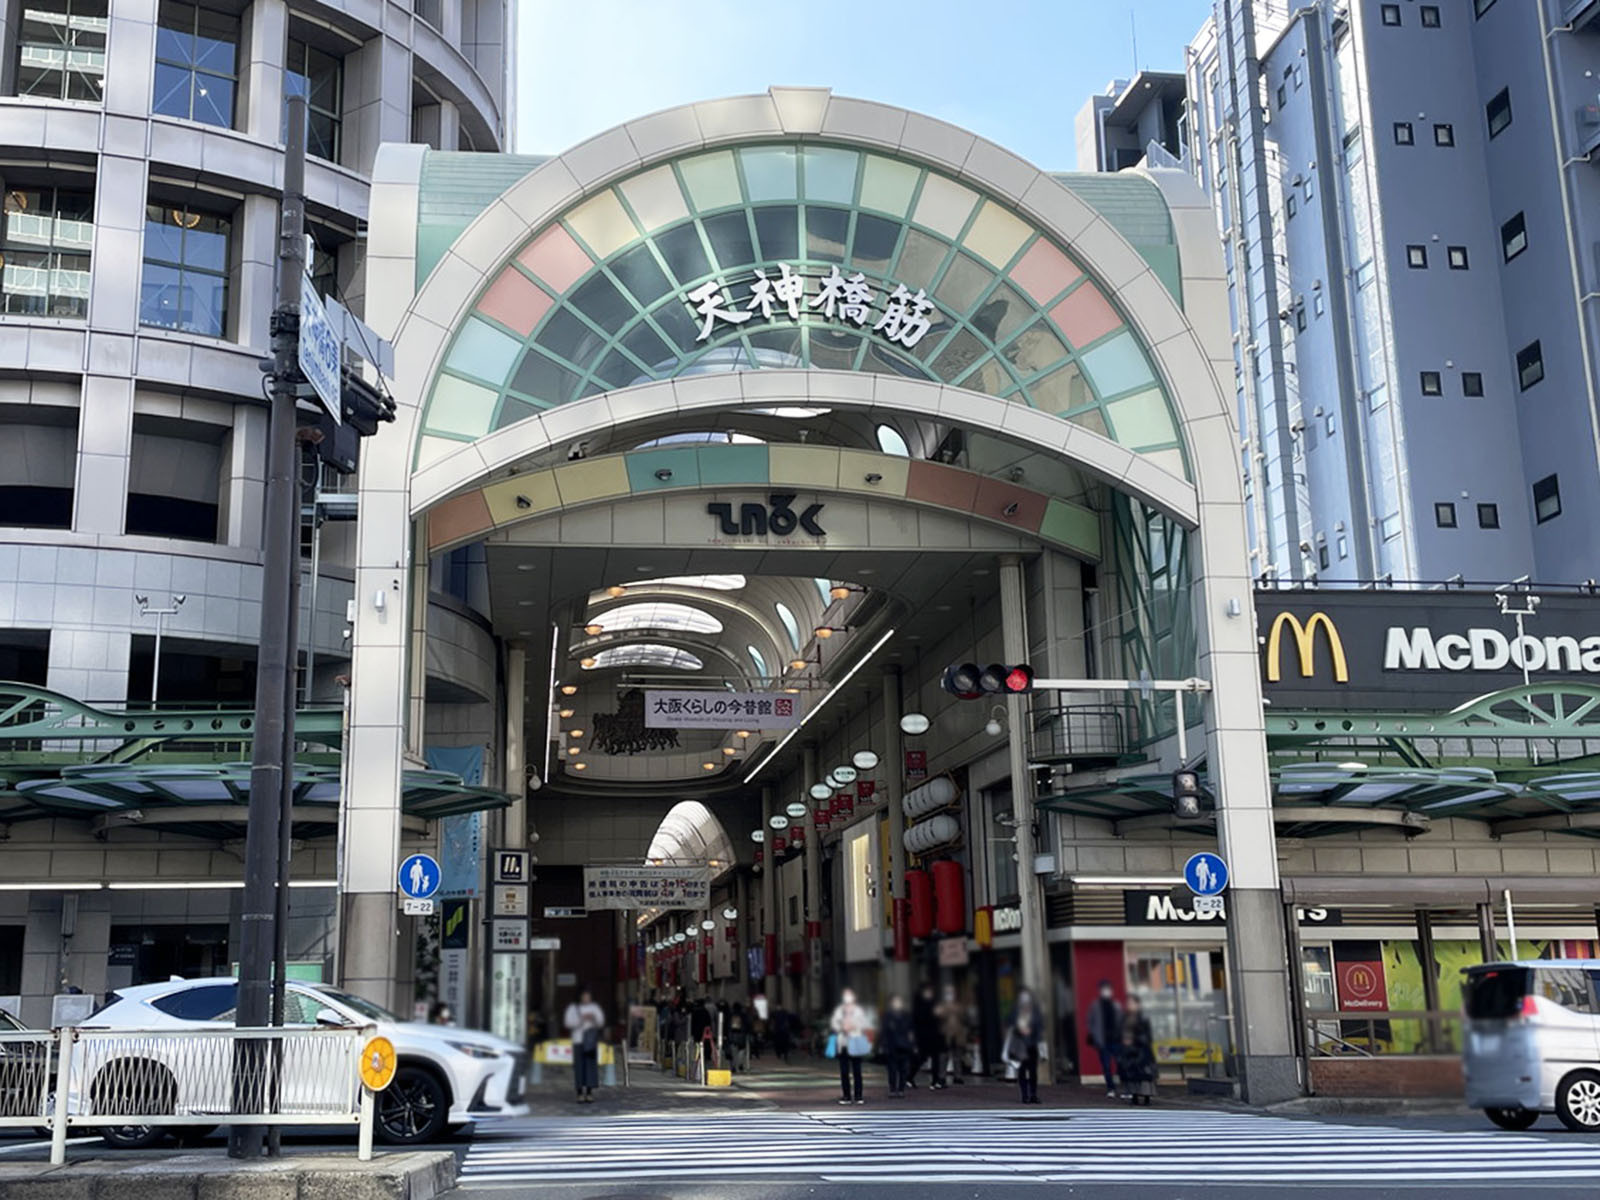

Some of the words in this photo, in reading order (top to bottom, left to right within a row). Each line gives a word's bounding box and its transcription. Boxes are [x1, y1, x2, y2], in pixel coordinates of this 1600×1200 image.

[688, 262, 935, 348] 天神橋筋
[653, 698, 772, 716] 大阪くらしの今昔館
[1343, 1000, 1383, 1009] McDelivery
